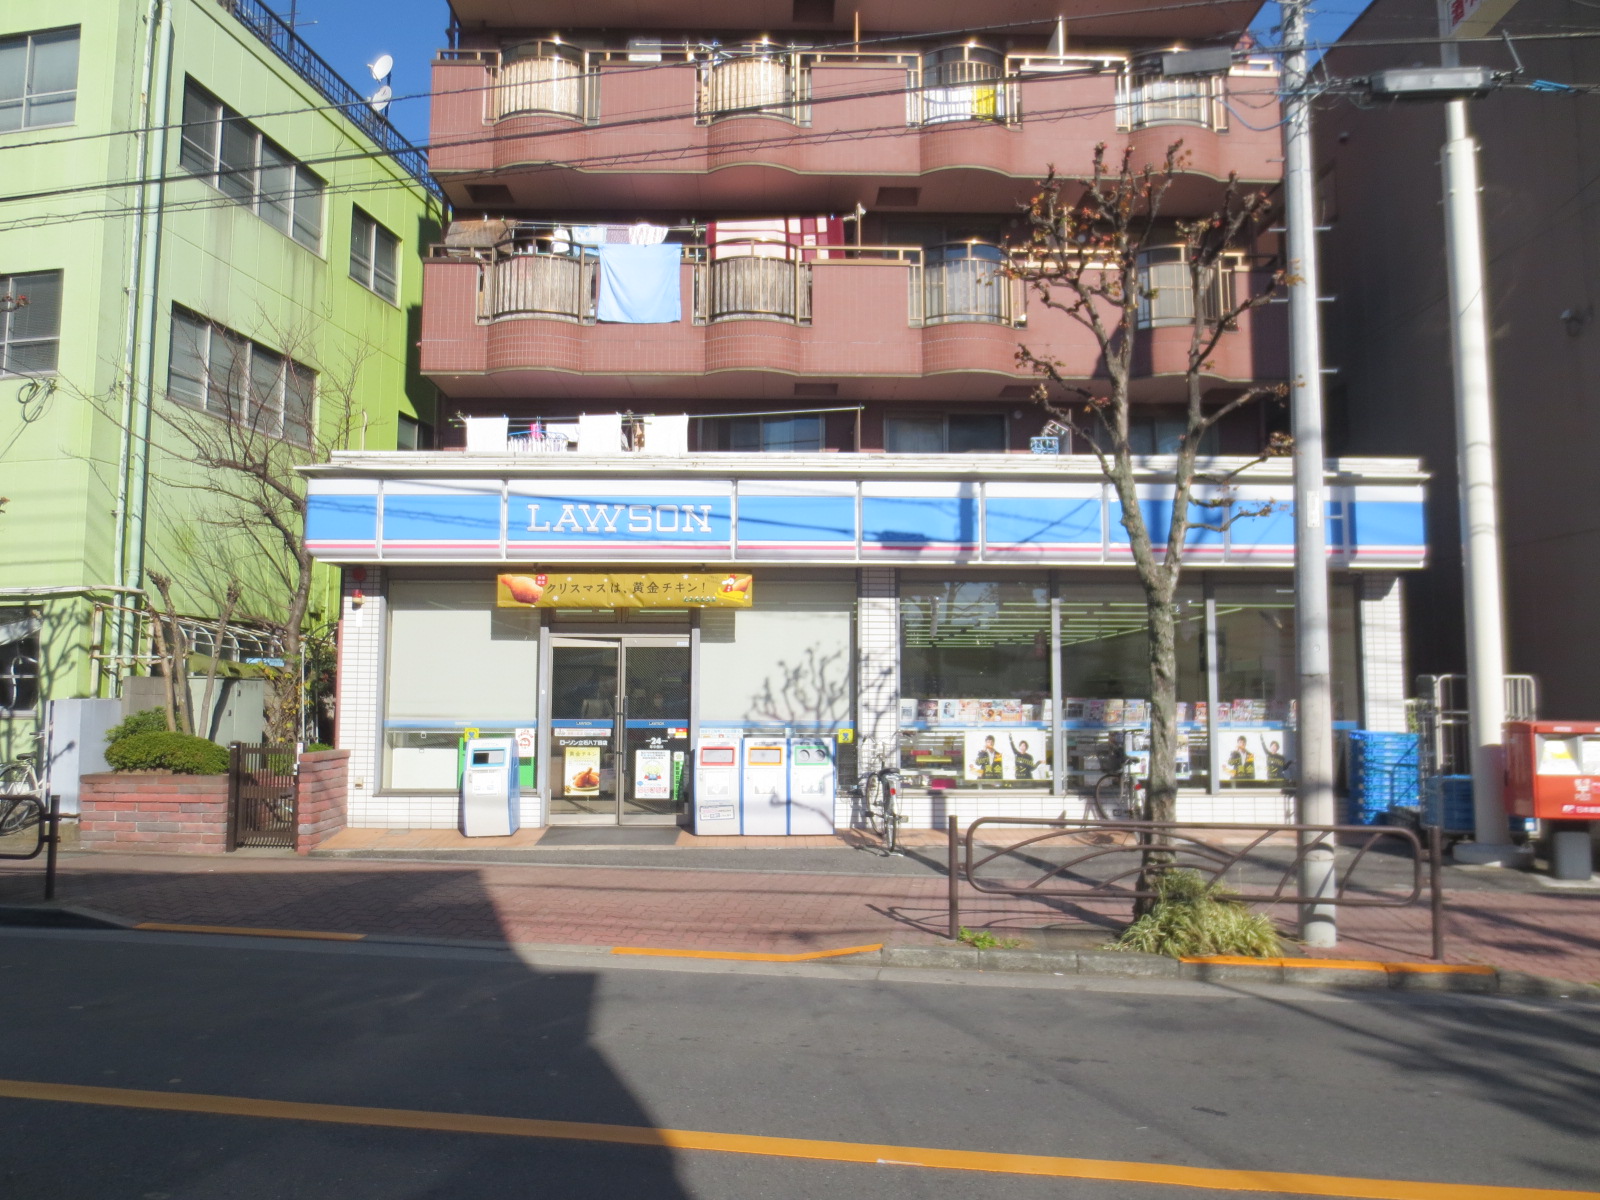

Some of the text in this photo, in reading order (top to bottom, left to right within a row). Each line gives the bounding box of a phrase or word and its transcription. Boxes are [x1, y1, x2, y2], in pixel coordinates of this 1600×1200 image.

[527, 504, 712, 532] LAWSON
[546, 581, 706, 595] クリスマスは、黄金チキン！
[650, 737, 662, 745] 24
